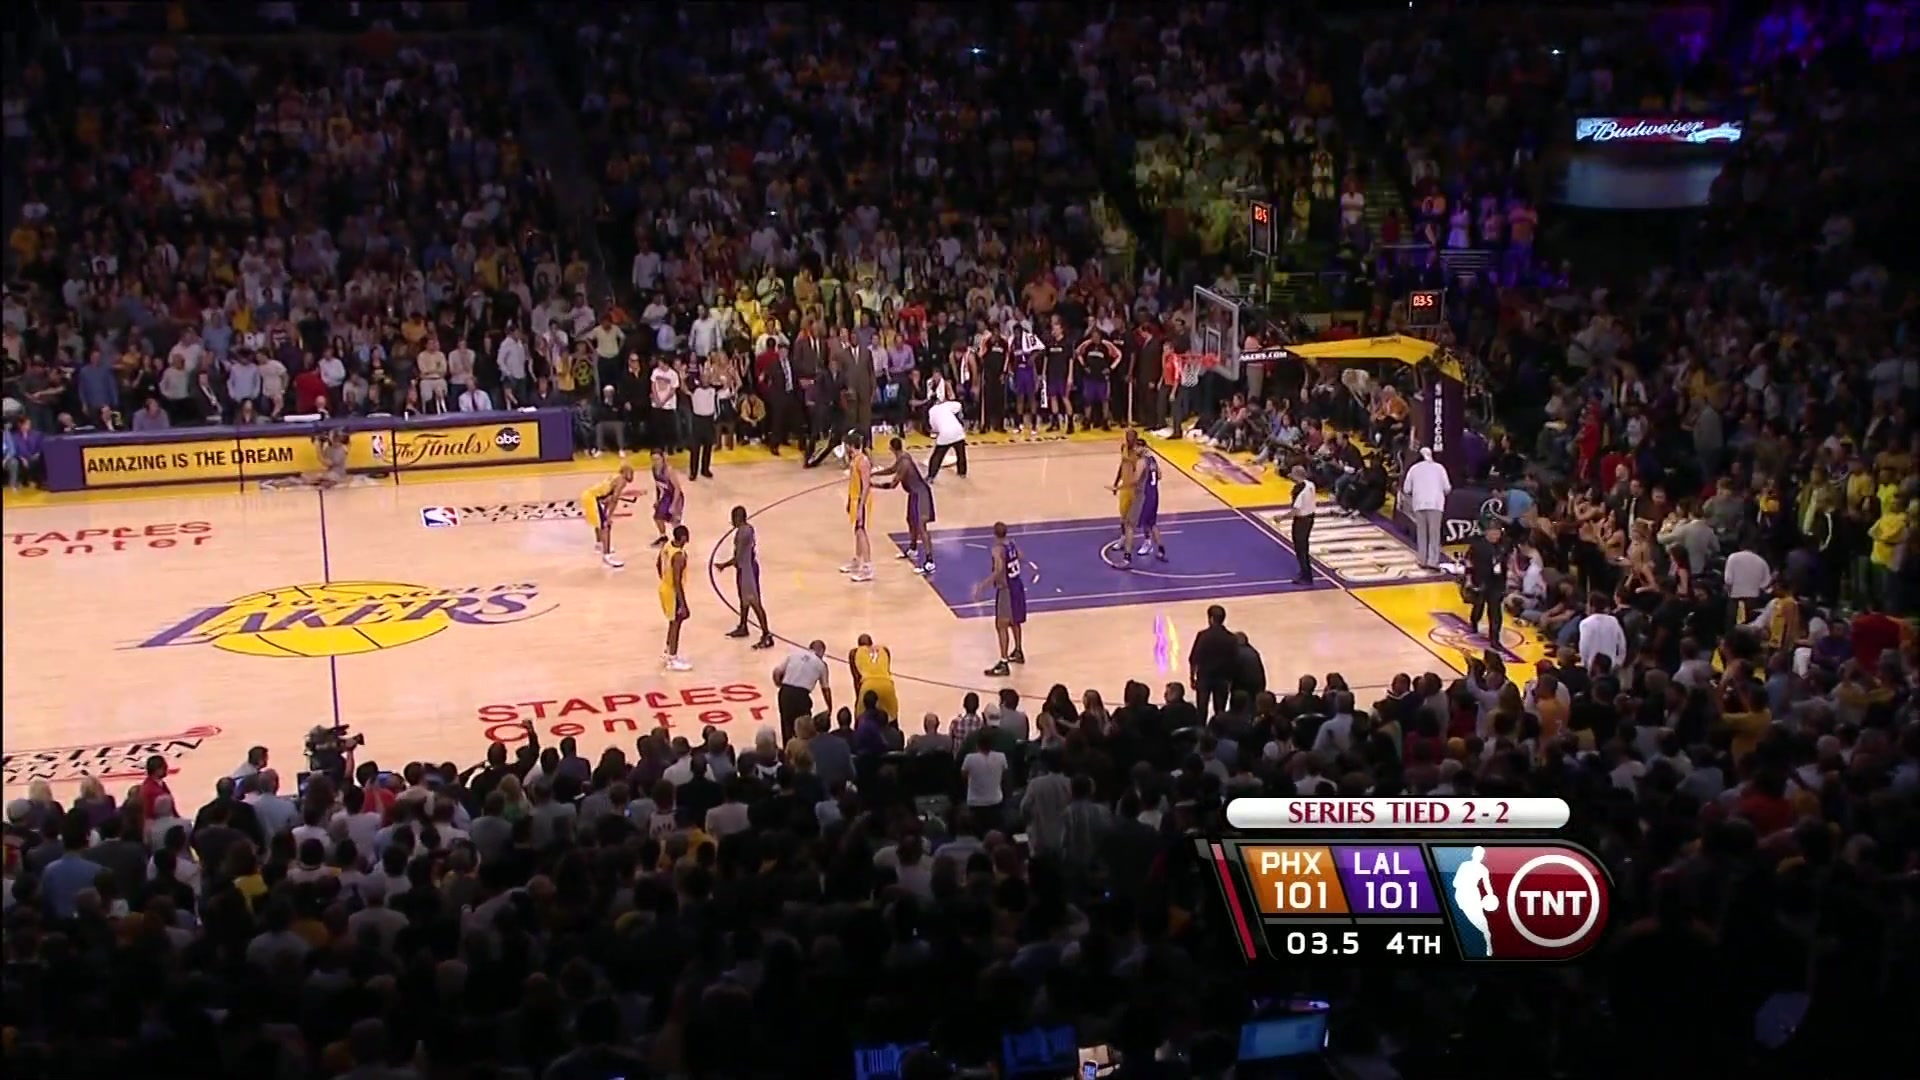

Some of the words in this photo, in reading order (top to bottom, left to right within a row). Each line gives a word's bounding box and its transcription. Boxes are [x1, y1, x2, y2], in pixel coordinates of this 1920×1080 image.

[1593, 119, 1704, 141] Budweiser
[410, 432, 490, 465] Finals
[495, 434, 521, 445] abc
[87, 454, 168, 473] AMAZING
[172, 452, 189, 468] IS
[195, 450, 227, 466] THE
[232, 447, 293, 464] DREAM
[134, 590, 558, 648] LAKERS
[478, 684, 762, 723] STAPLES
[484, 706, 769, 742] Center
